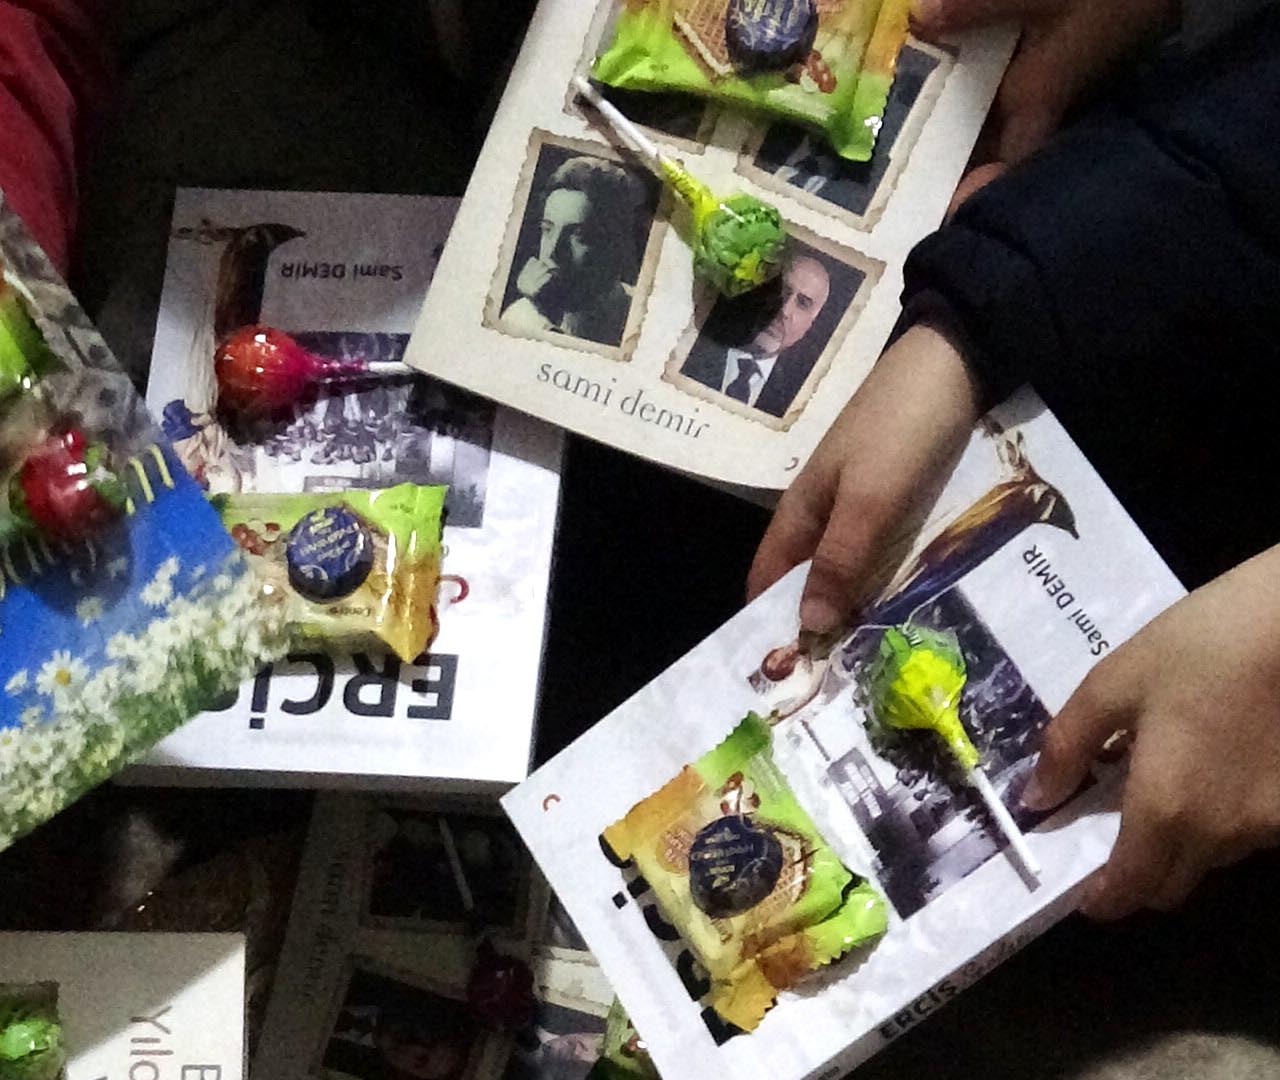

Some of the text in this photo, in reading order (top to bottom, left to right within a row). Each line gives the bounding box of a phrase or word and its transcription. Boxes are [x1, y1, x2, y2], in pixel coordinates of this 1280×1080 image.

[353, 263, 403, 281] Sami
[536, 362, 710, 439] sami demir
[1022, 544, 1110, 656] Sami DEMİR
[199, 653, 460, 730] ERCİ
